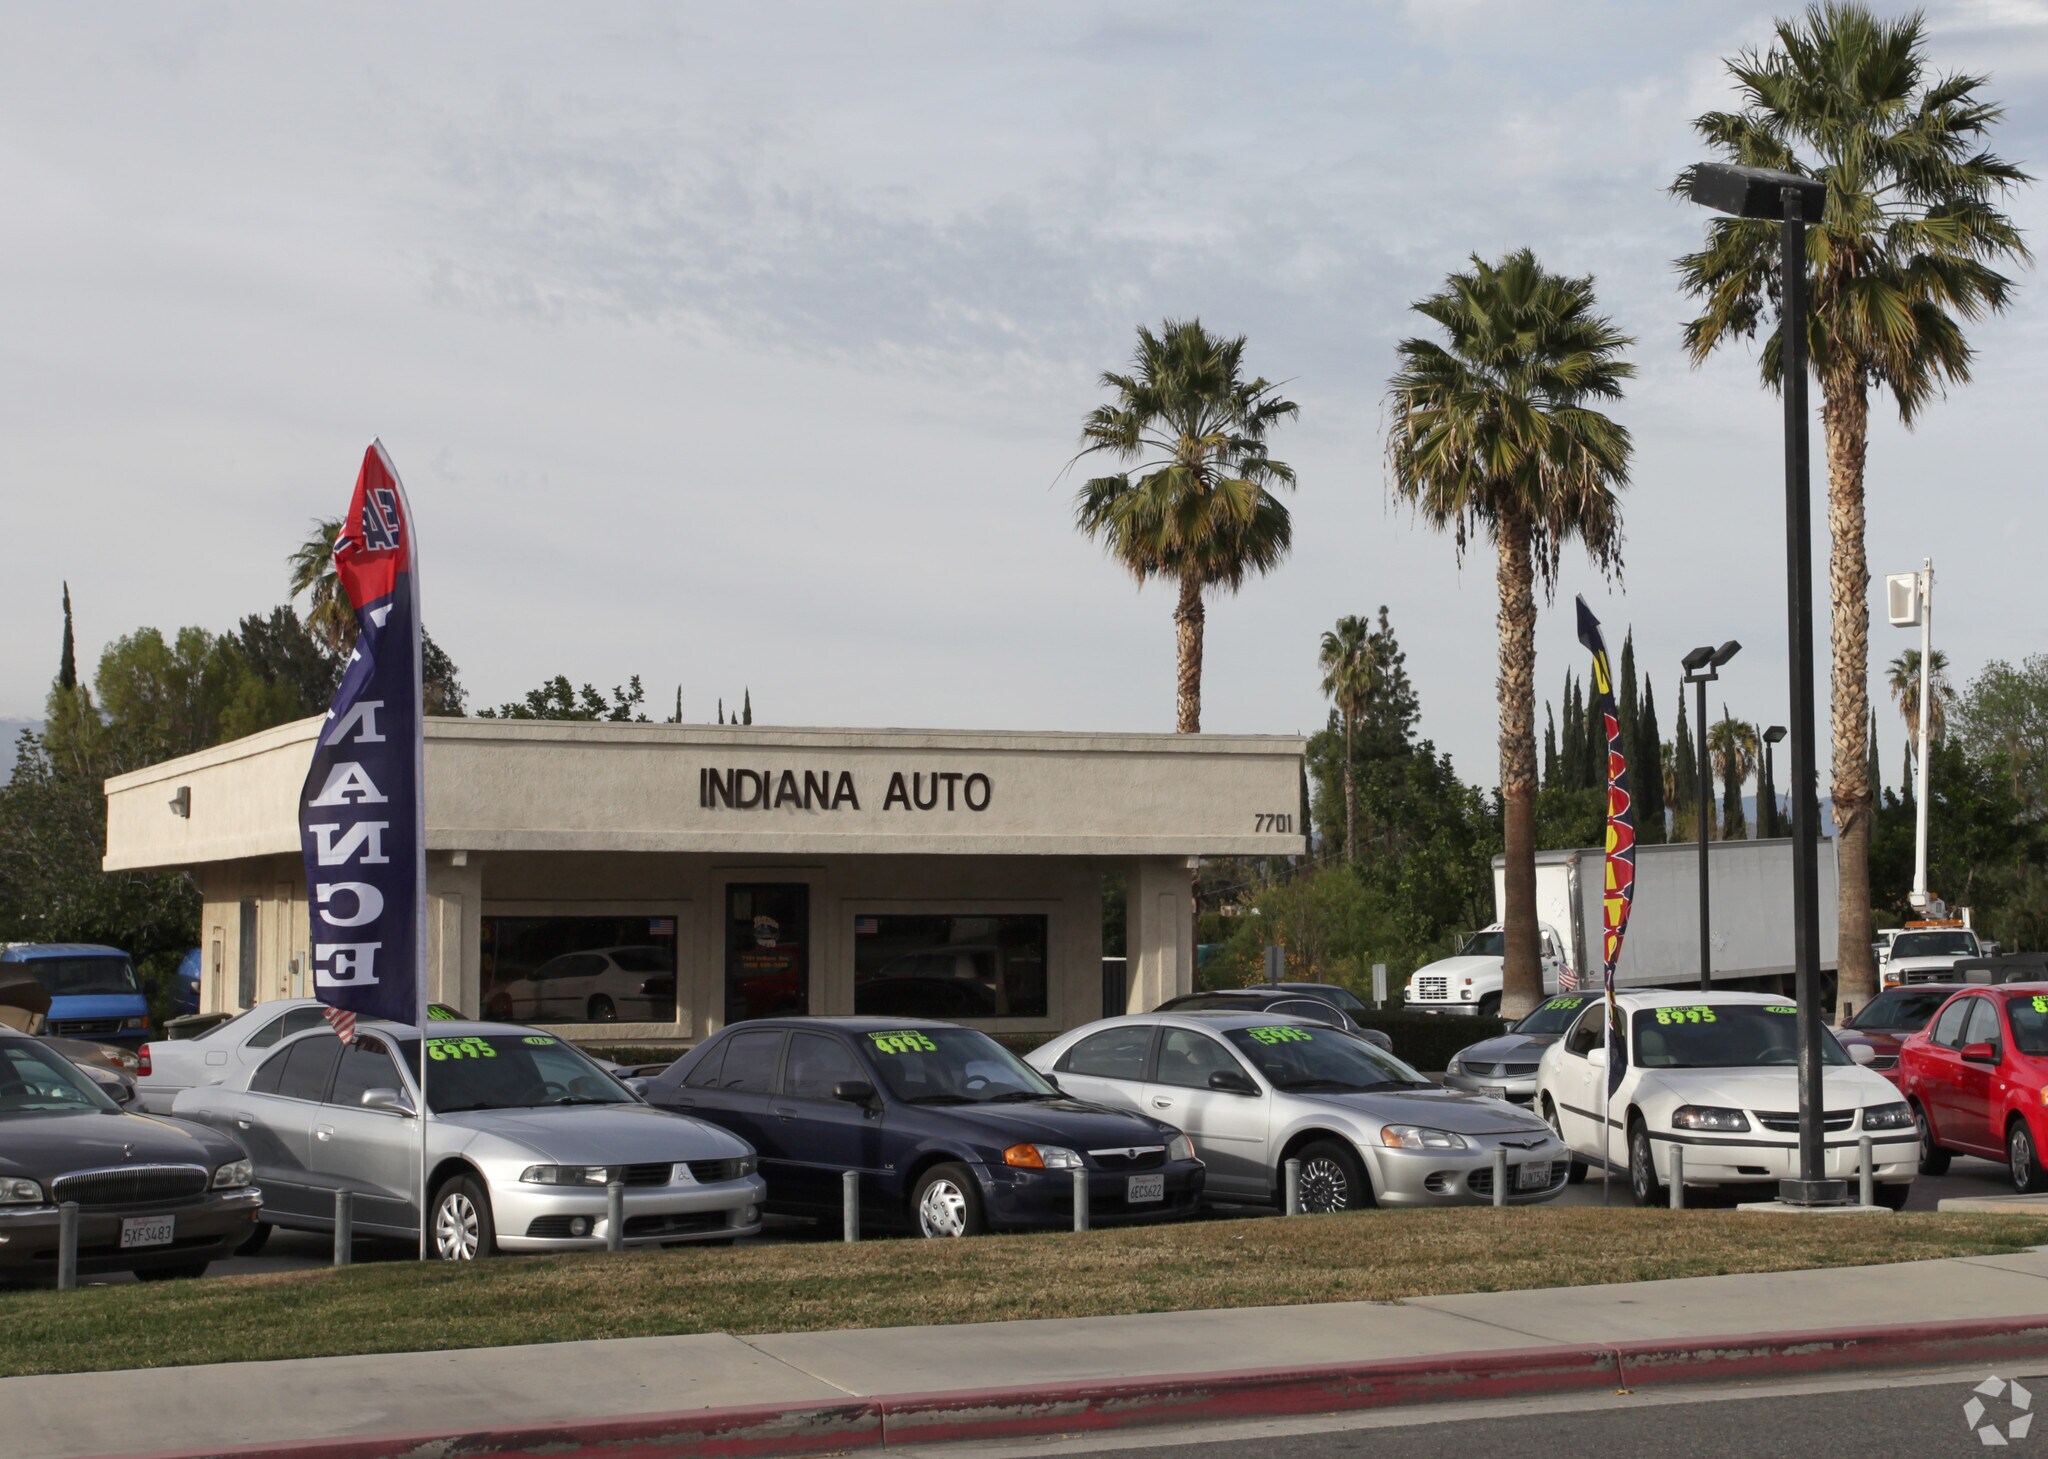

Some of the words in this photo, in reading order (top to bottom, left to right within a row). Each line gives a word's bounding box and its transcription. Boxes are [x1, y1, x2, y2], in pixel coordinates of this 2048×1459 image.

[700, 768, 860, 810] INDIANA
[882, 772, 991, 811] AUTO
[1255, 813, 1292, 833] 7701
[1655, 1010, 1718, 1025] 8995
[428, 1042, 497, 1061] 6995
[875, 1035, 938, 1055] 4995
[1130, 1184, 1162, 1199] 6ECS622
[124, 1226, 171, 1243] 5XFS483
